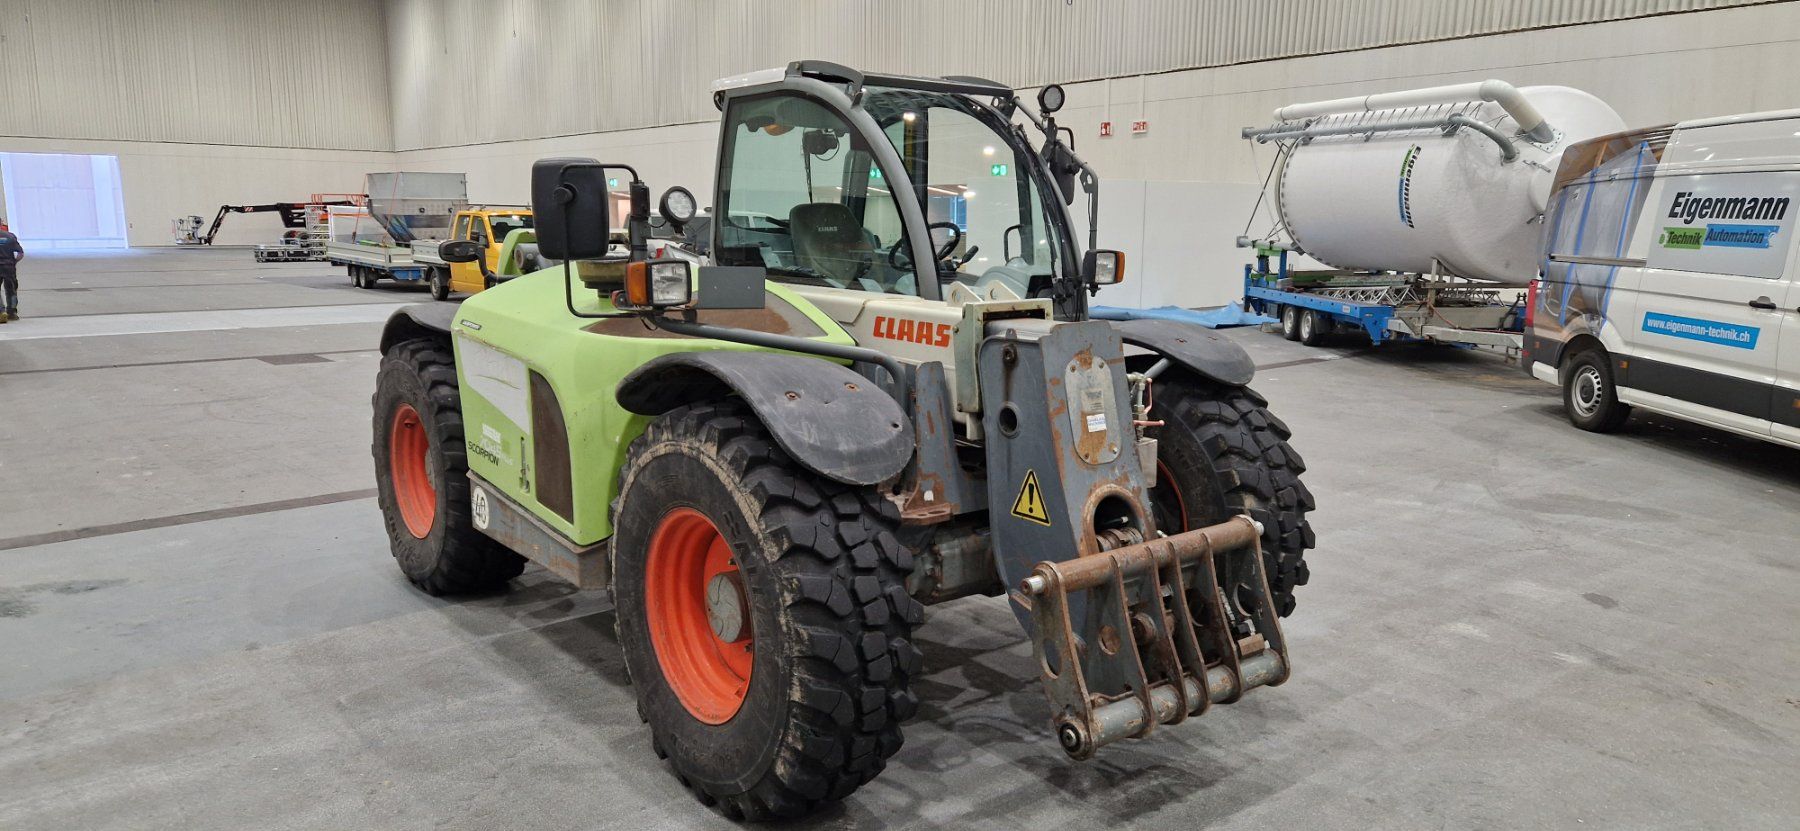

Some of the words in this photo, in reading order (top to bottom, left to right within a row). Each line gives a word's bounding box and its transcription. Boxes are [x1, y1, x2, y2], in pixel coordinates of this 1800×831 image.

[1404, 146, 1422, 228] Eigenmann
[1668, 192, 1790, 224] Eigenmann
[1667, 231, 1702, 246] Technik
[1705, 228, 1765, 243] Automation
[873, 315, 952, 348] CLAAS
[1647, 318, 1750, 342] www.eigenmann-technik.ch
[468, 440, 500, 467] SCORPION
